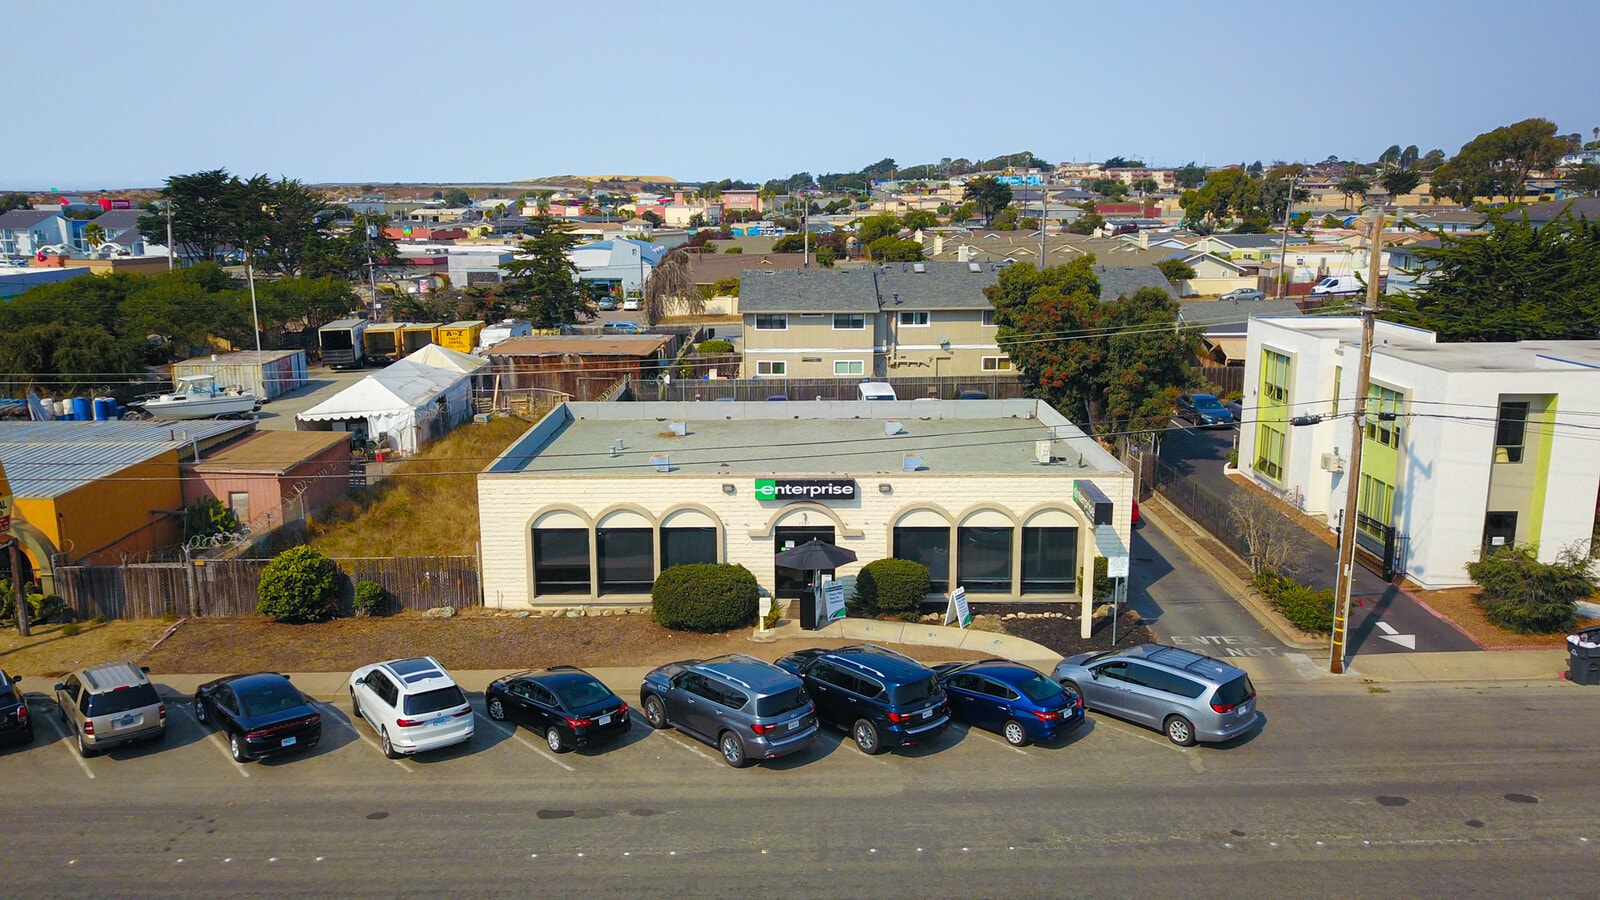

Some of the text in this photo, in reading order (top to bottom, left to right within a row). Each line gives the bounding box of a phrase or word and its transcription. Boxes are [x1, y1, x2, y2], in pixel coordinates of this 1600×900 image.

[760, 483, 853, 497] enterprise
[1170, 635, 1259, 645] ENTER
[1225, 647, 1277, 657] NOT
